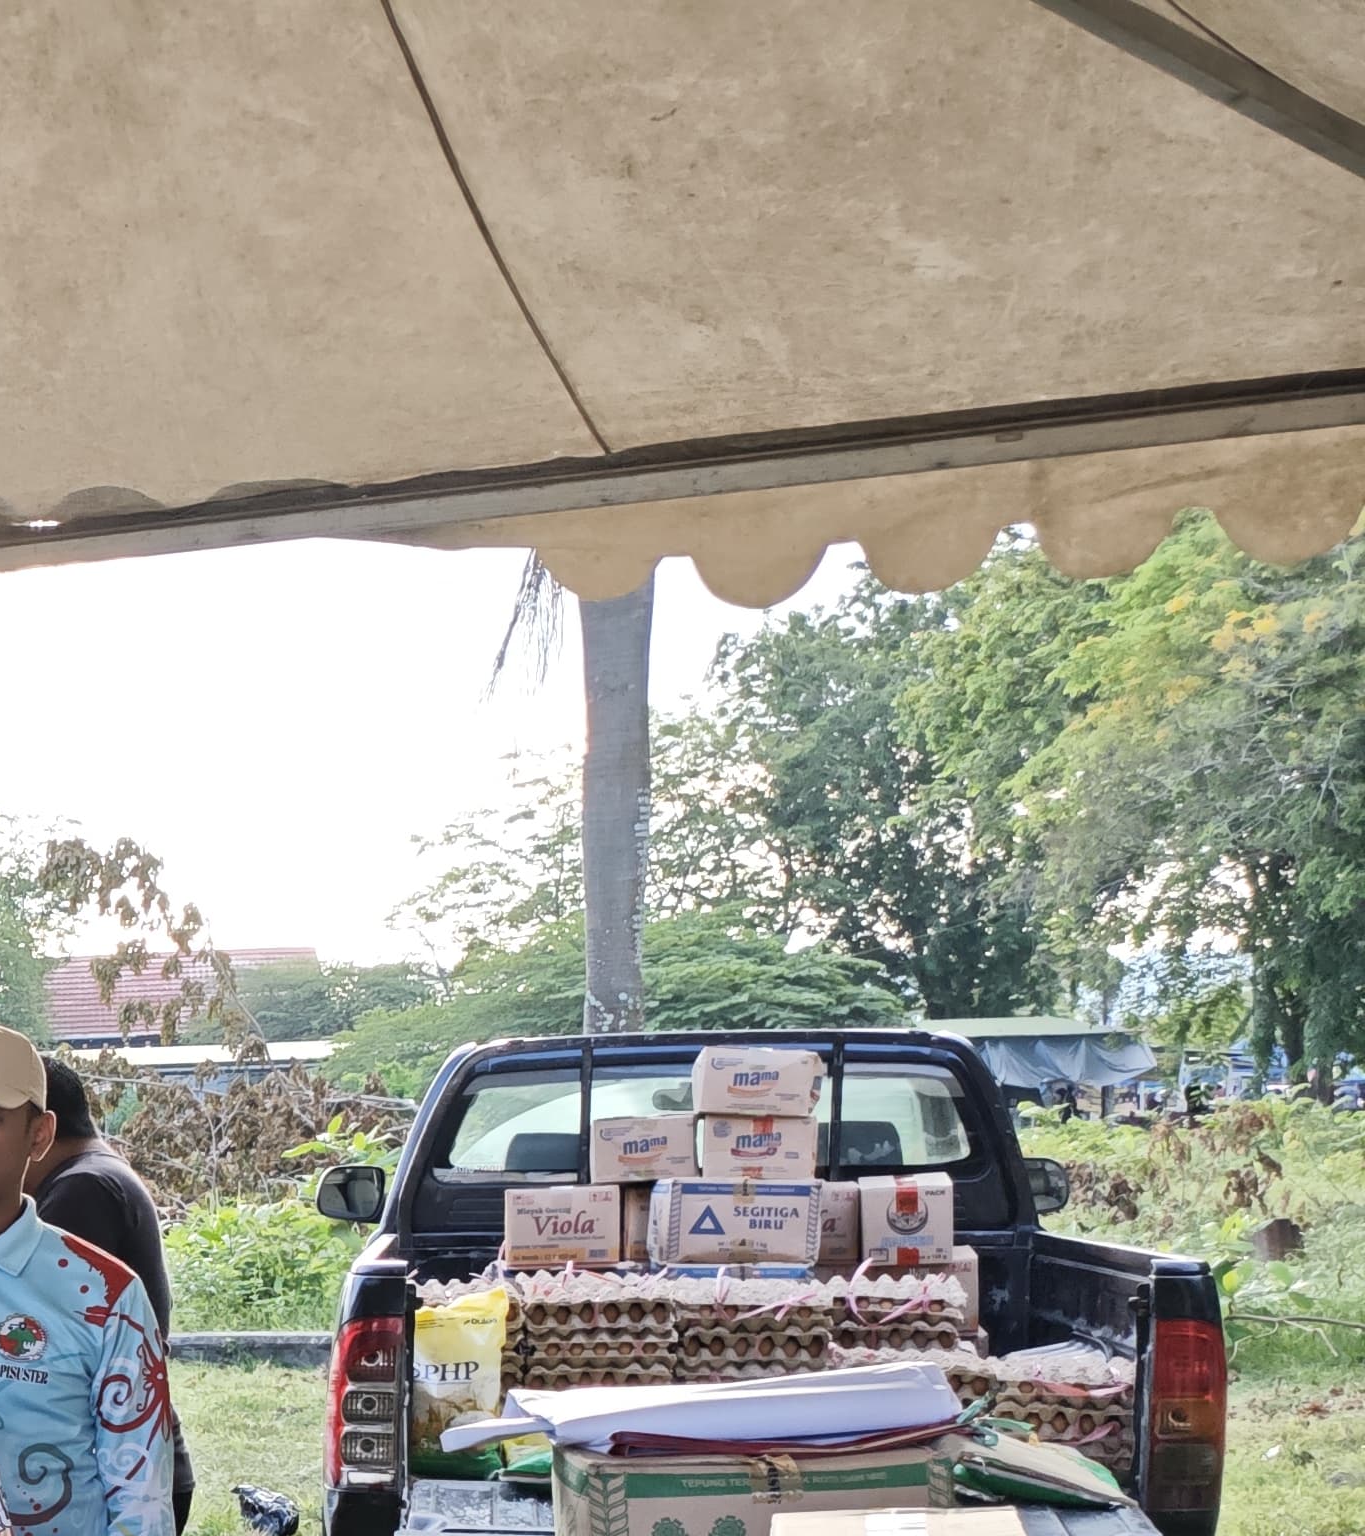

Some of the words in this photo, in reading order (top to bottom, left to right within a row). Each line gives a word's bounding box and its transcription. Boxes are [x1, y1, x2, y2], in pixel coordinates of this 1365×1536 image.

[732, 1071, 780, 1086] mama
[623, 1136, 667, 1155] mama
[736, 1131, 782, 1149] mama
[733, 1206, 800, 1218] SEGITIGA
[532, 1210, 595, 1235] Viola
[749, 1219, 784, 1230] BIRU
[681, 1479, 726, 1488] TEPUNG
